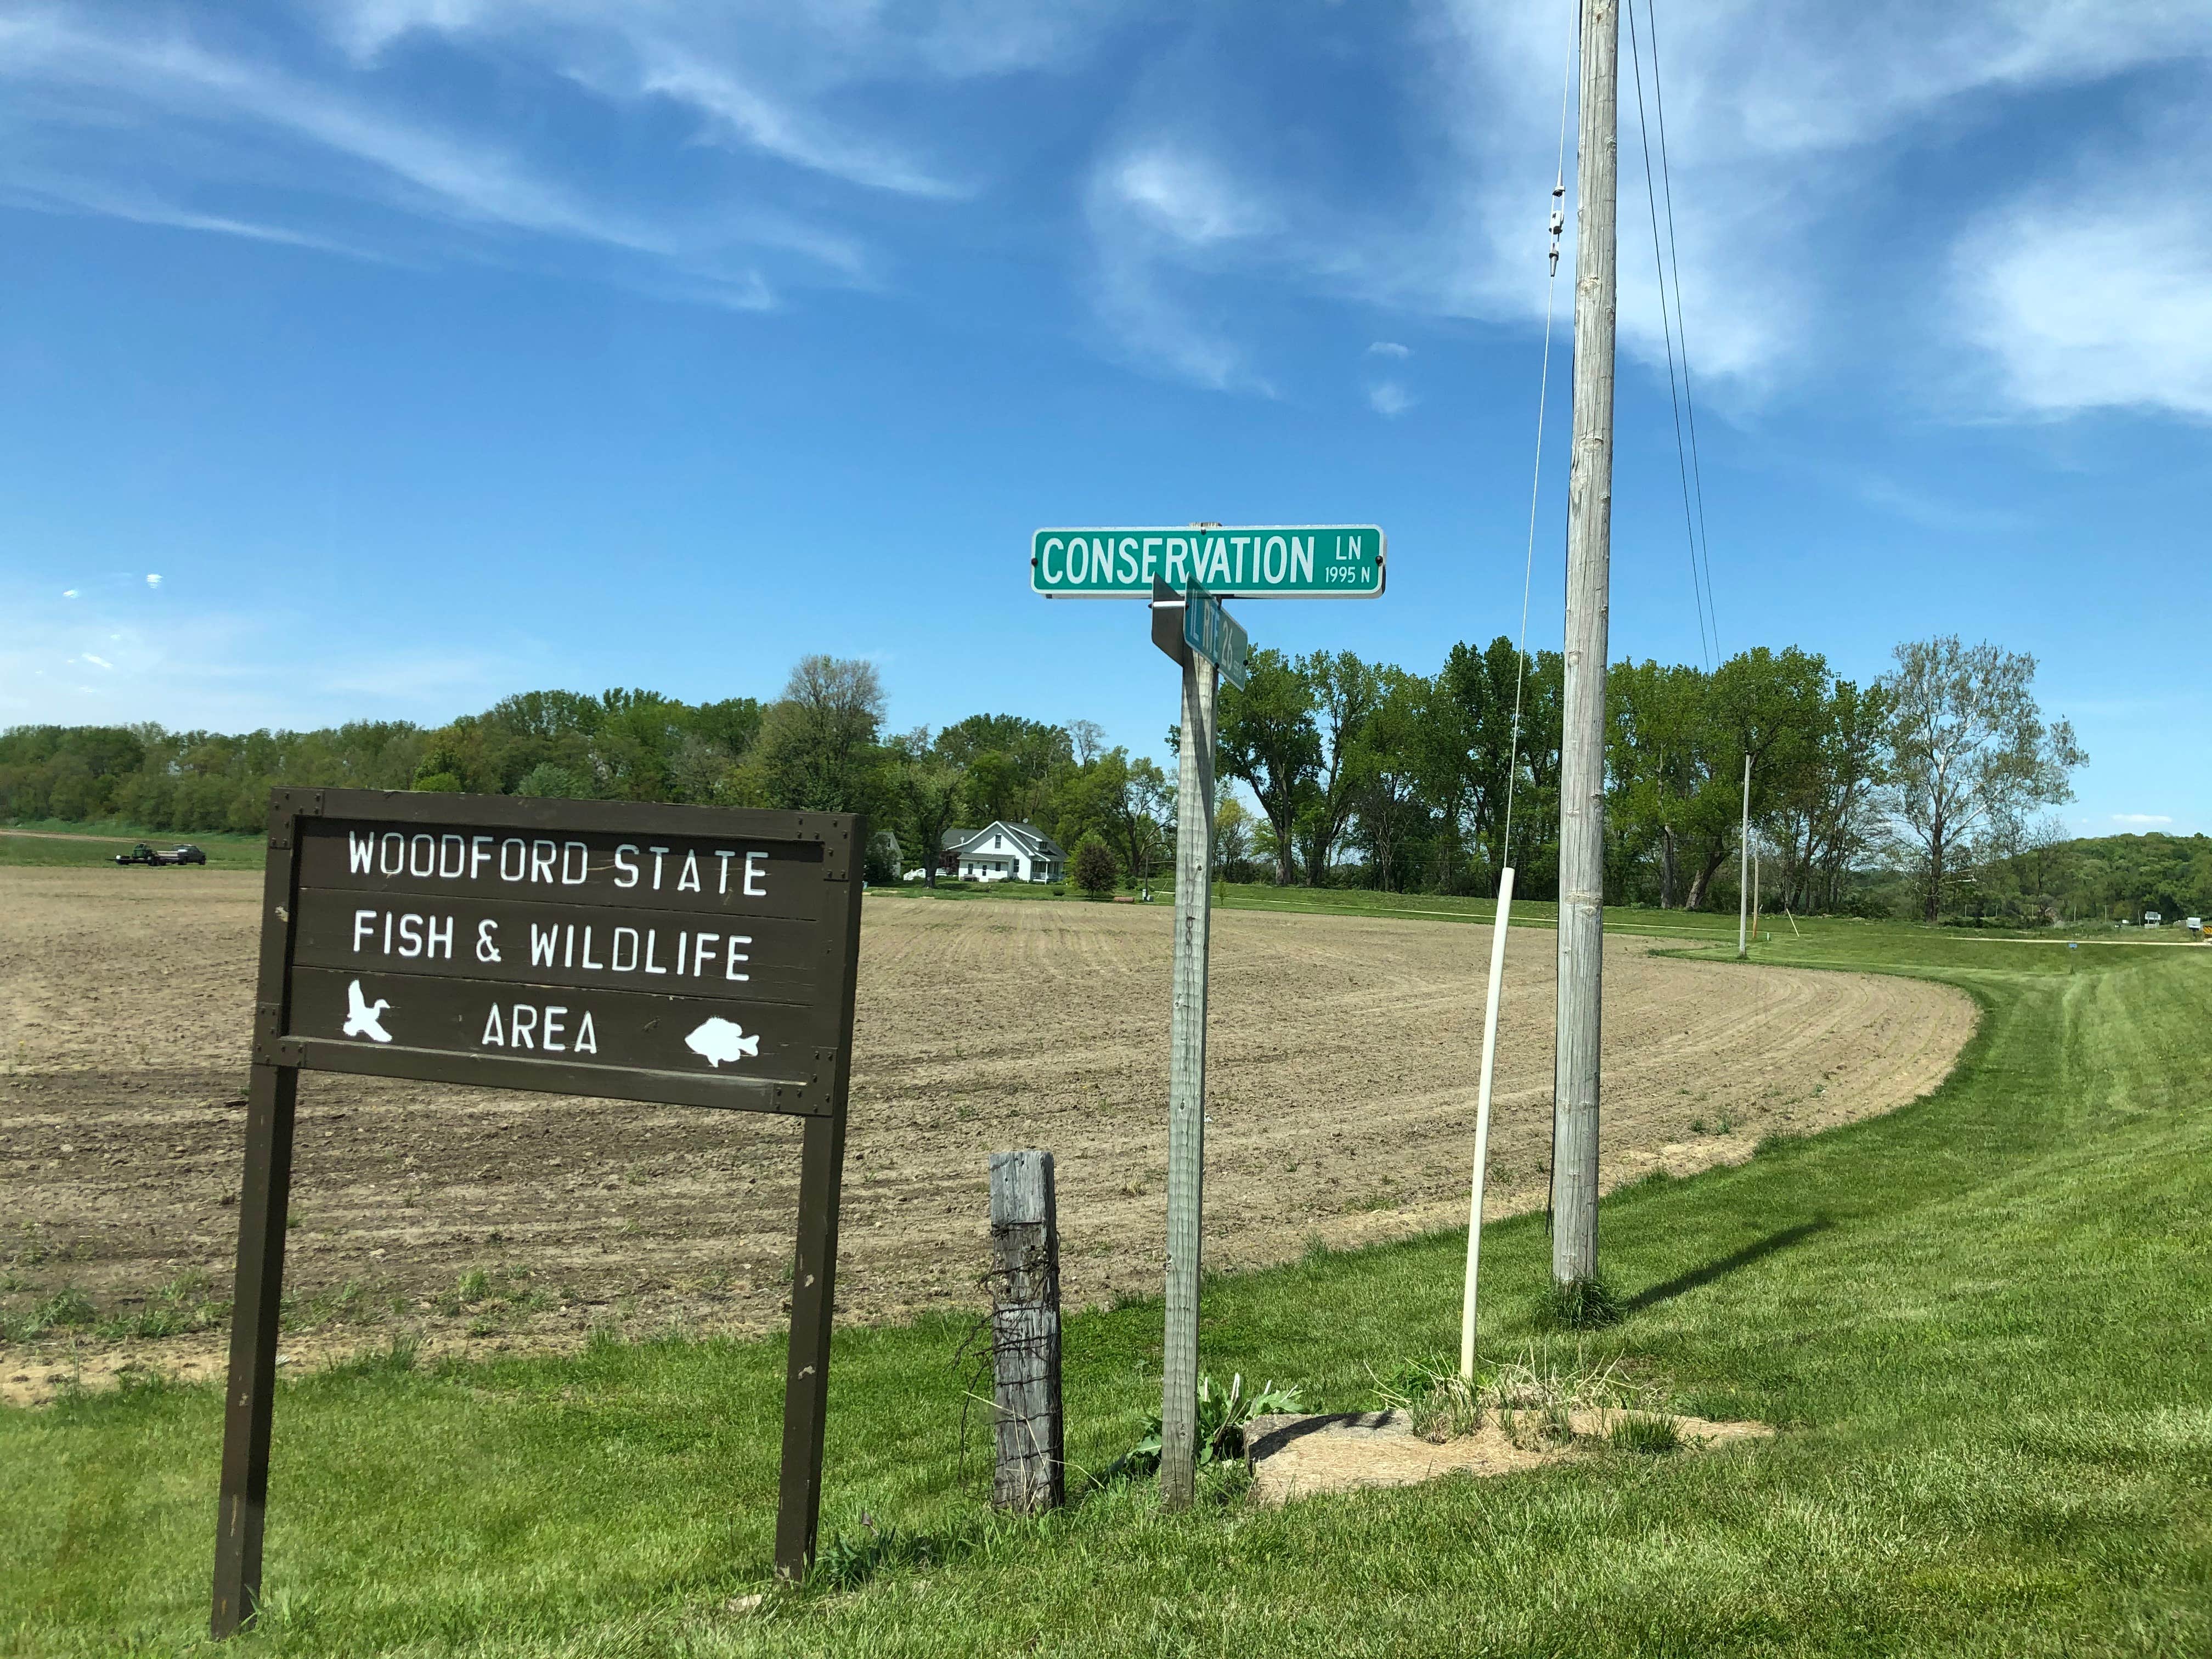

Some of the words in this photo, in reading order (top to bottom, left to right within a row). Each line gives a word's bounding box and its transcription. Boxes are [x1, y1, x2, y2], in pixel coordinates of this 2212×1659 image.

[1042, 535, 1314, 584] CONSERVATION
[1336, 535, 1361, 560] LN
[1325, 566, 1356, 583] 1995
[1361, 566, 1370, 583] N
[1203, 600, 1220, 659] RTE
[1221, 620, 1233, 672] 26
[349, 831, 589, 885] WOODFORD
[613, 844, 769, 896] STATE
[353, 909, 454, 959] FISH
[476, 919, 502, 963] &
[531, 923, 753, 981] WILDLIFE
[481, 1002, 598, 1055] AREA
